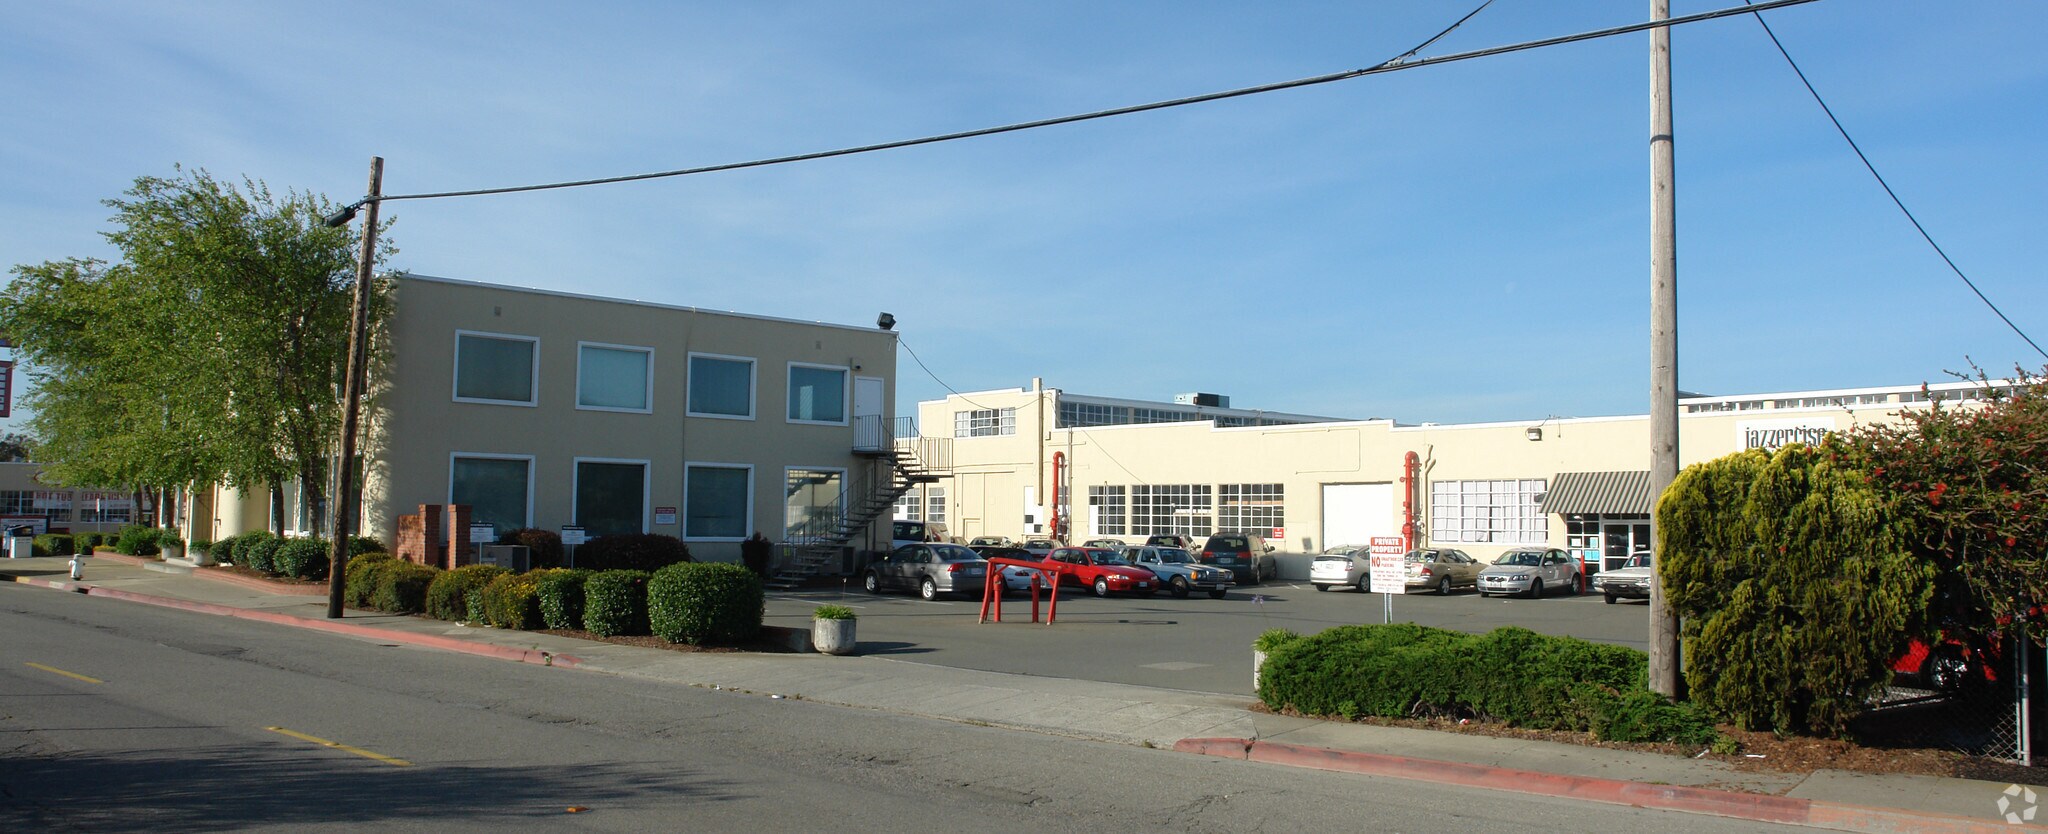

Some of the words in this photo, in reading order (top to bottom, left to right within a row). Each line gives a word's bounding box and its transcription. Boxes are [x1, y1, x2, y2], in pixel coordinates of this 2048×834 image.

[1745, 425, 1827, 448] jazzercise
[1371, 545, 1403, 553] PROPERTY
[1371, 556, 1381, 567] NO
